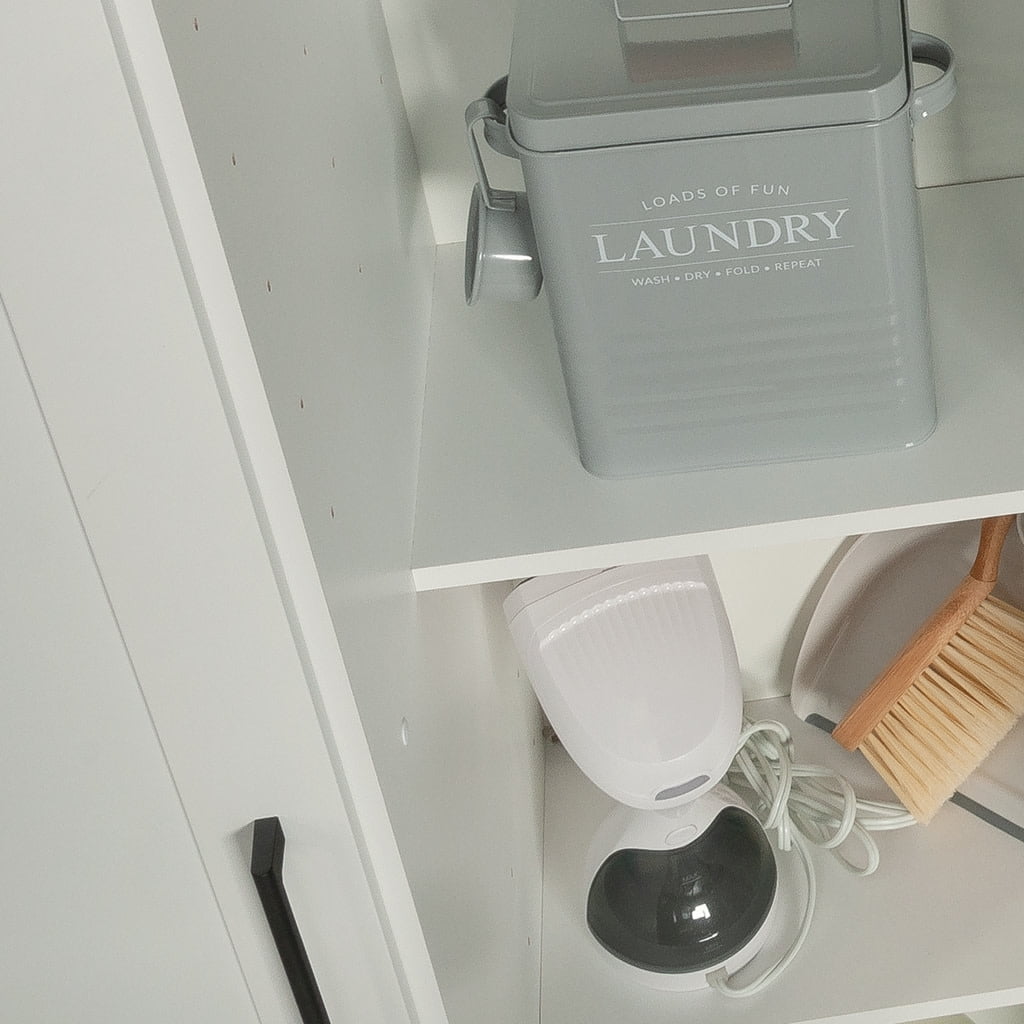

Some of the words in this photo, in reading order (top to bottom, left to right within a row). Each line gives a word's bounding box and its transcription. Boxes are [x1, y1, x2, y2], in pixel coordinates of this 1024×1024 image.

[641, 188, 707, 211] LOADS
[715, 184, 740, 197] OF
[751, 184, 790, 196] FUN
[591, 208, 849, 264] LAUNDRY
[631, 275, 671, 287] WASH
[685, 270, 711, 282] DRY
[726, 264, 760, 277] FOLD
[774, 258, 823, 271] REPEAT
